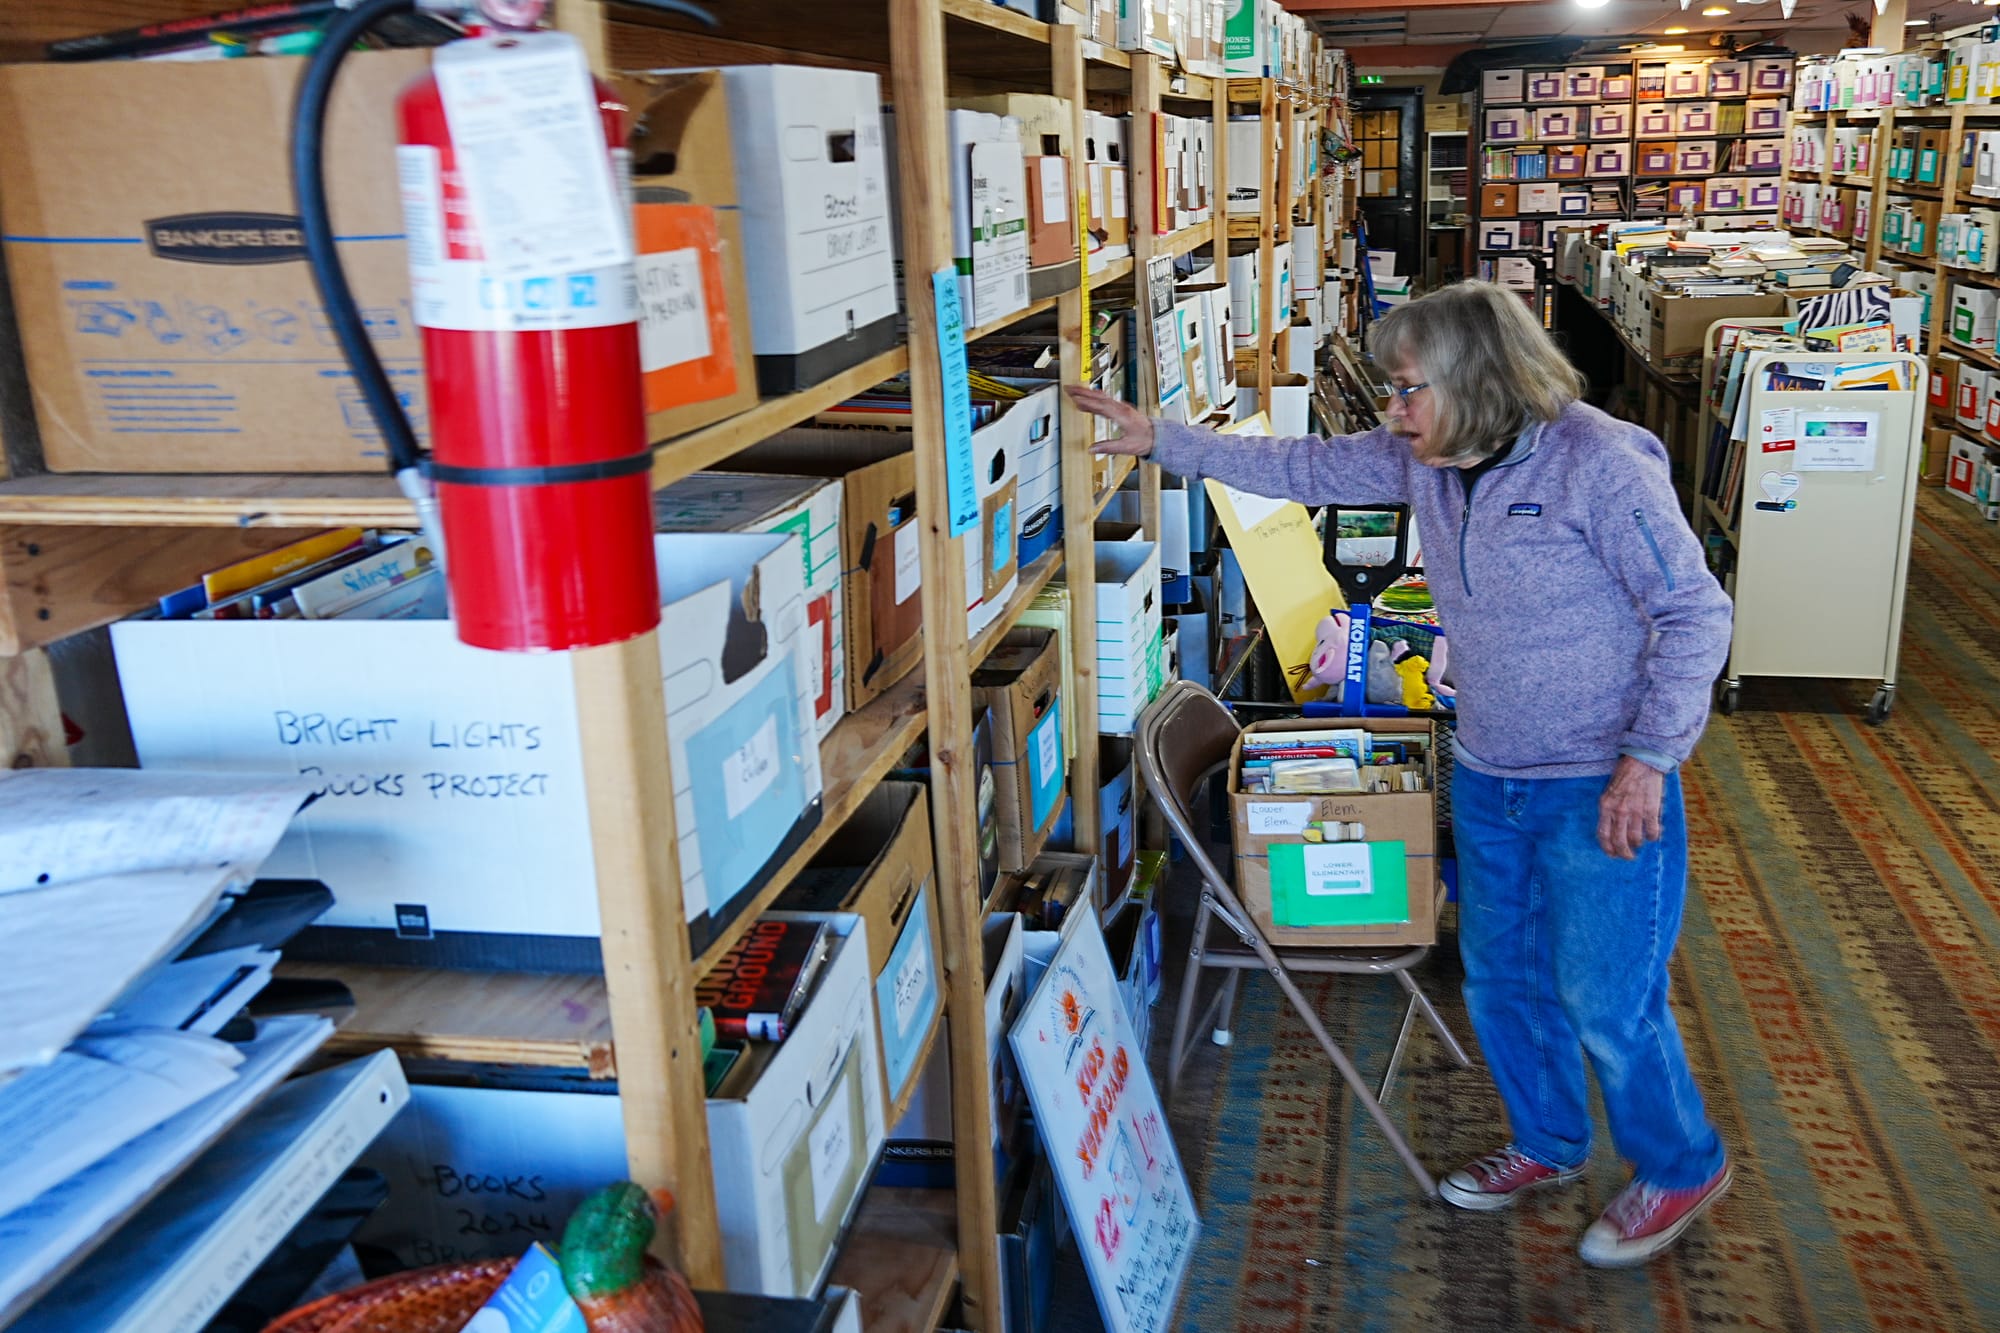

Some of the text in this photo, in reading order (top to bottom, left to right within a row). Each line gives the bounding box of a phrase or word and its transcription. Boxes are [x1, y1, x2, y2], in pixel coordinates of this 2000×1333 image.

[156, 228, 305, 249] BANKERS BO
[1347, 618, 1366, 683] KOBALT
[274, 710, 541, 750] BRIGHT LIGHTS
[422, 772, 549, 797] PROJECT
[1251, 805, 1285, 814] Lower
[1321, 799, 1363, 817] Elem.
[1264, 816, 1292, 828] Elem.
[721, 922, 788, 1009] GROUND
[1076, 1036, 1105, 1107] KIDS
[886, 1146, 929, 1156] NKERS
[433, 1164, 546, 1201] BOOKS
[456, 1208, 551, 1236] 2024
